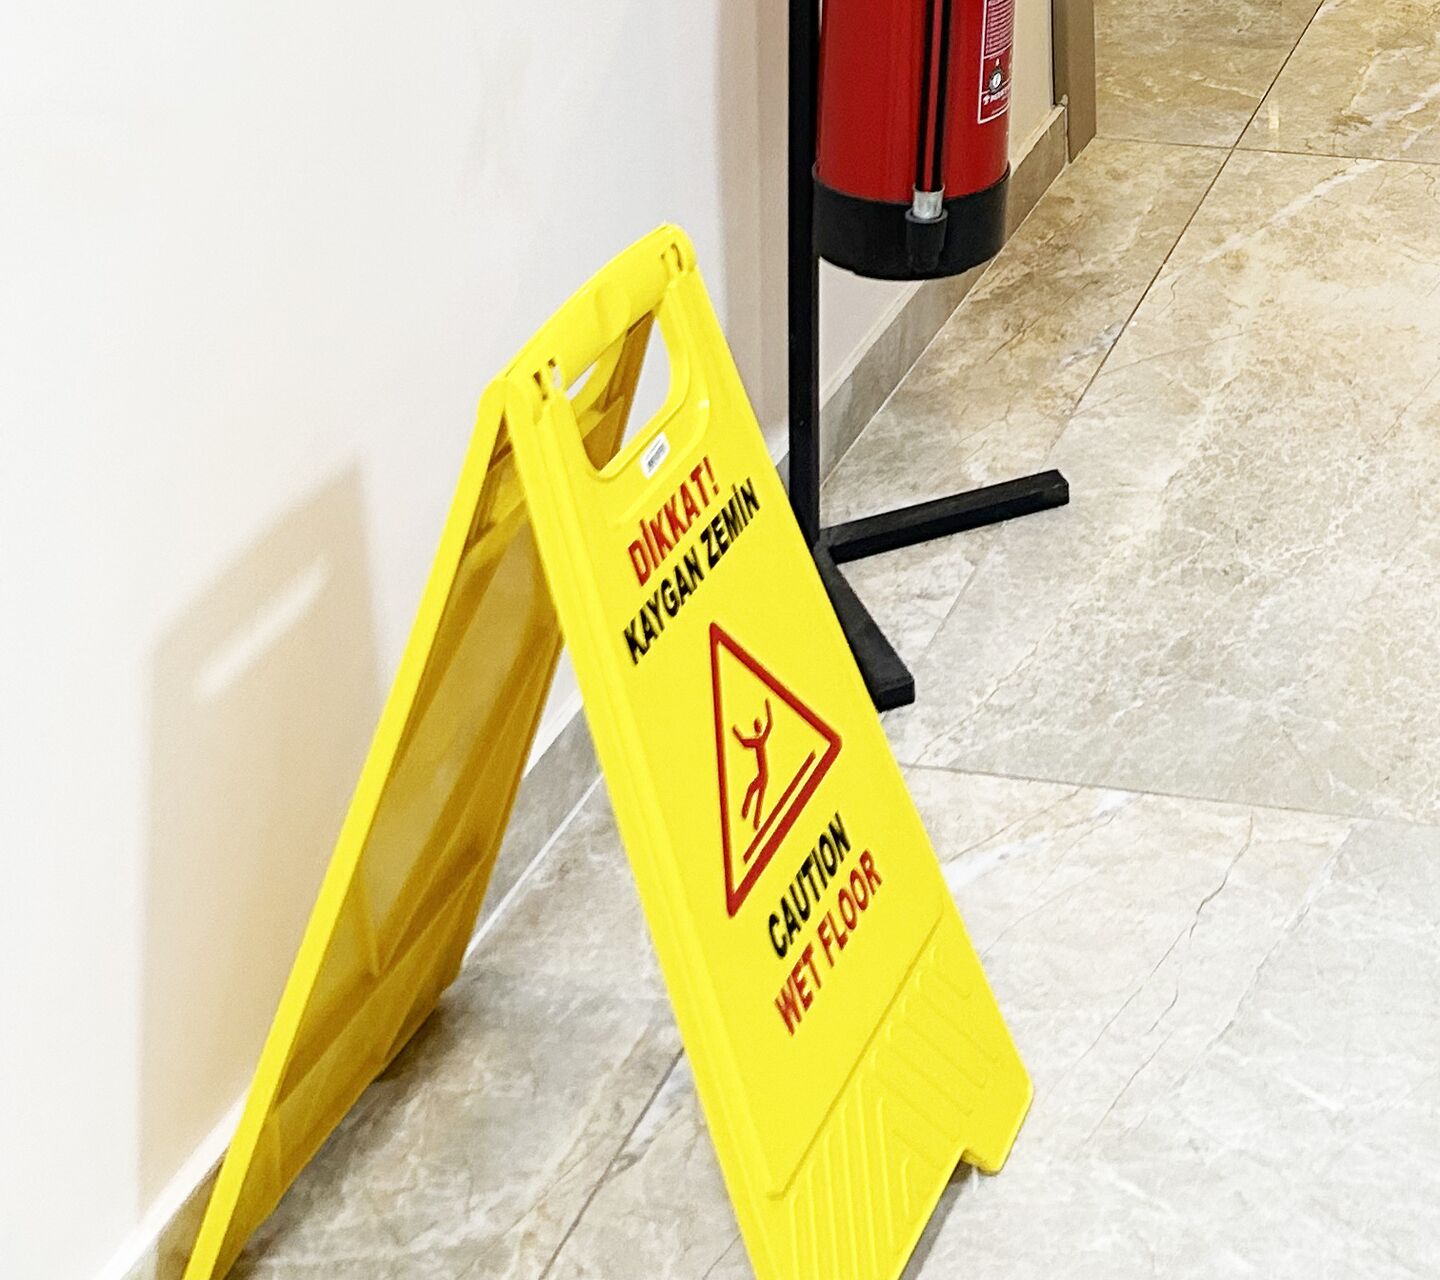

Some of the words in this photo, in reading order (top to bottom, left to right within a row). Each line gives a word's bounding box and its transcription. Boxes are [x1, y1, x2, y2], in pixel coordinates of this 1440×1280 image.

[623, 545, 704, 665] KAYGAN
[700, 477, 760, 570] ZEMİN
[628, 455, 719, 587] DİKKAT!
[768, 810, 851, 959] CAUTION
[774, 941, 821, 1037] WET
[817, 848, 882, 968] FLOOR
